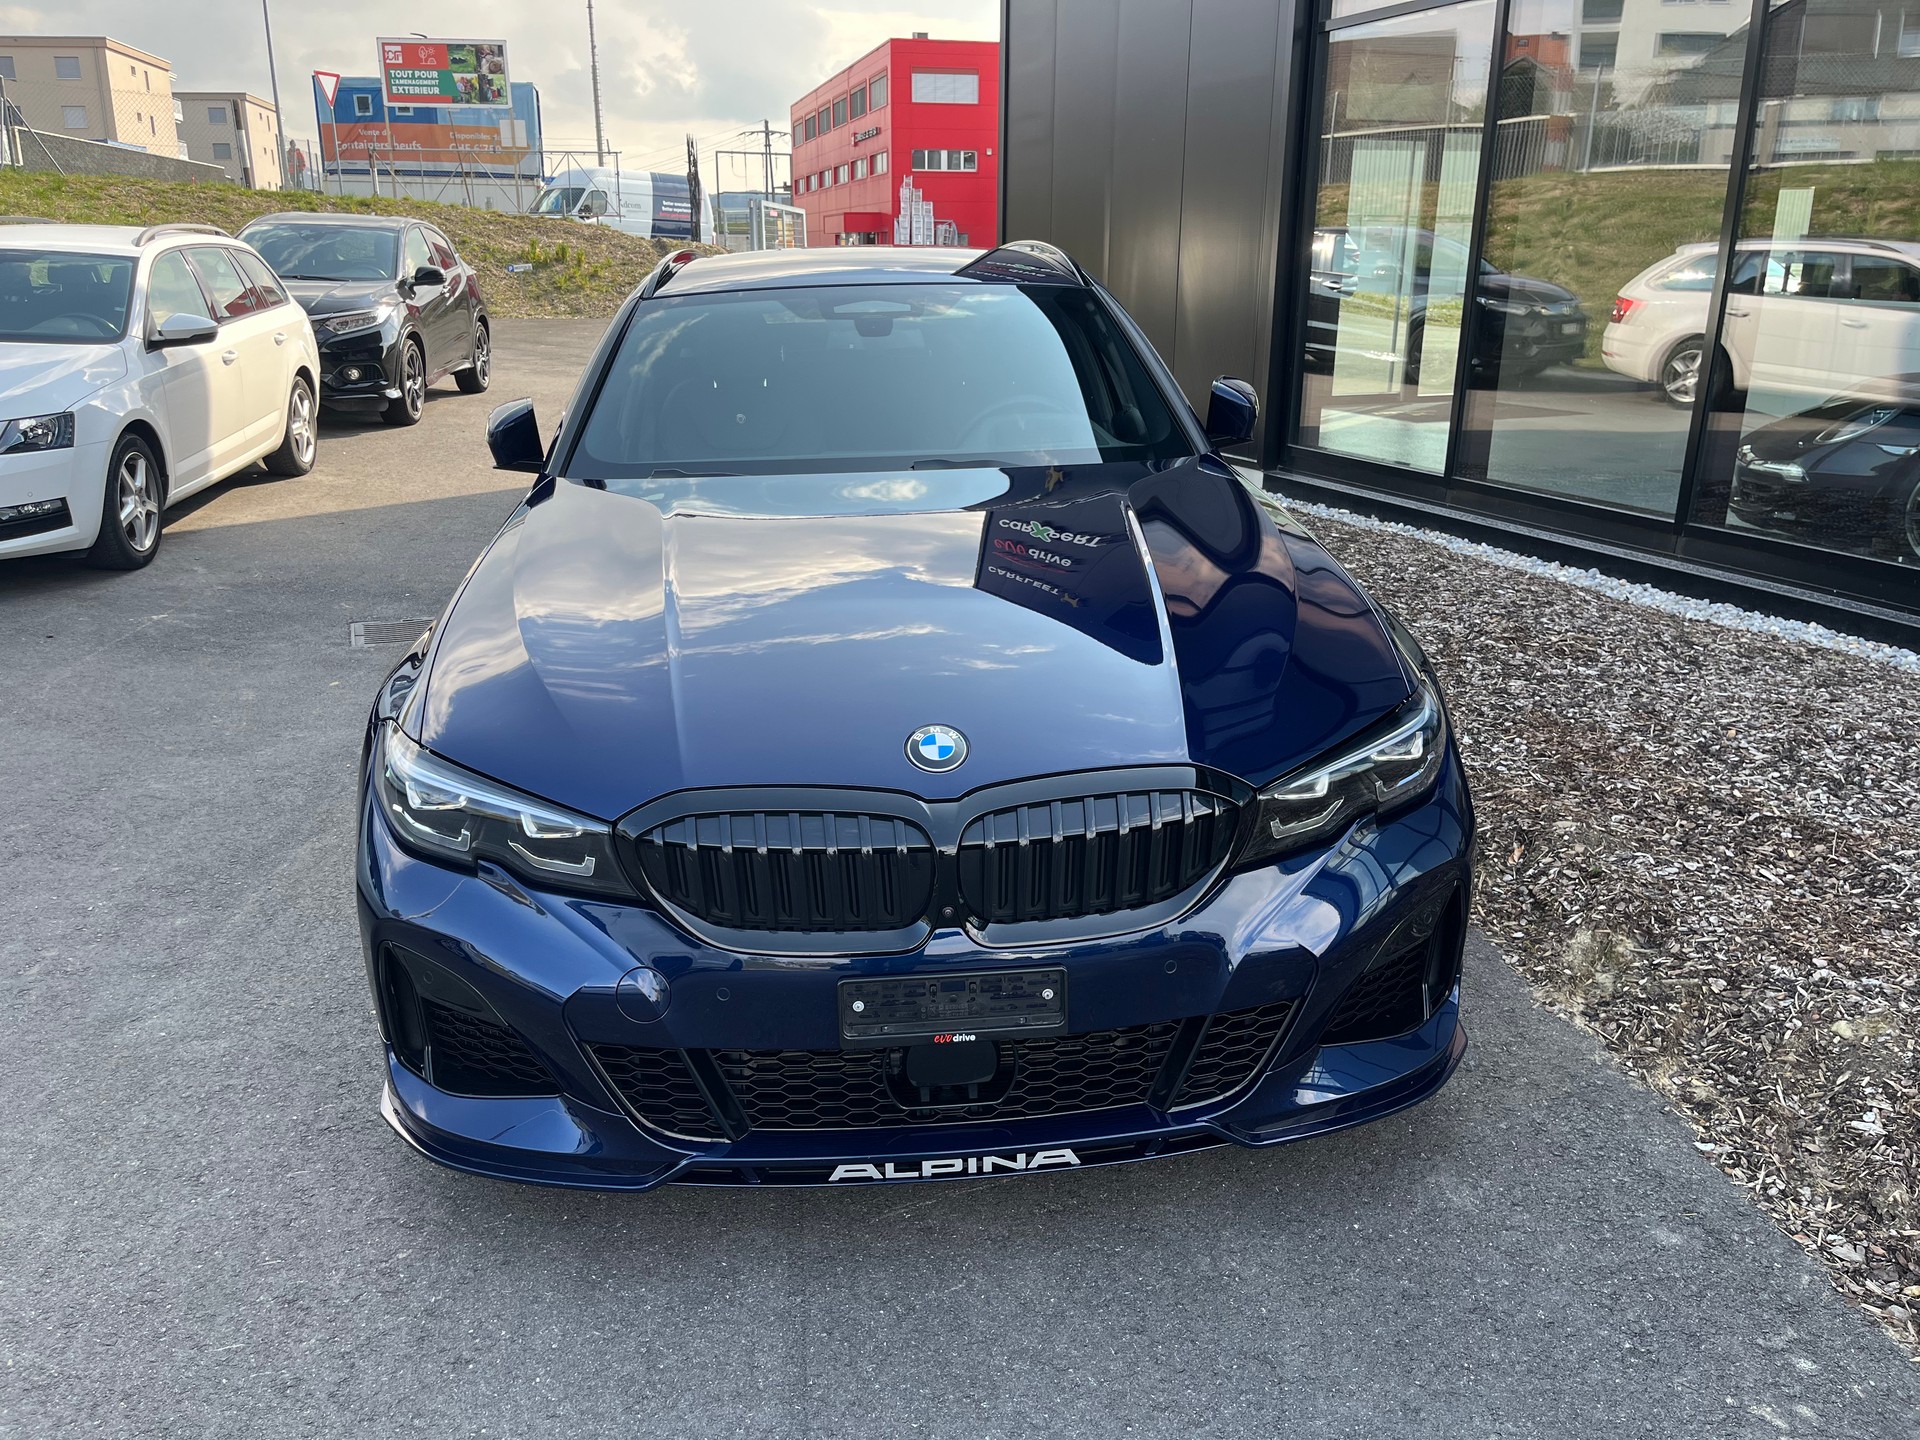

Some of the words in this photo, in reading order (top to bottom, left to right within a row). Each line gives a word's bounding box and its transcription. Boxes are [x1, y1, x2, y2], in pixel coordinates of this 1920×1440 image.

[389, 70, 413, 79] TOUT
[414, 70, 439, 79] POUR
[392, 86, 440, 95] EXTERIEUR
[913, 727, 959, 741] BMW
[828, 1148, 1082, 1182] ALPINA
